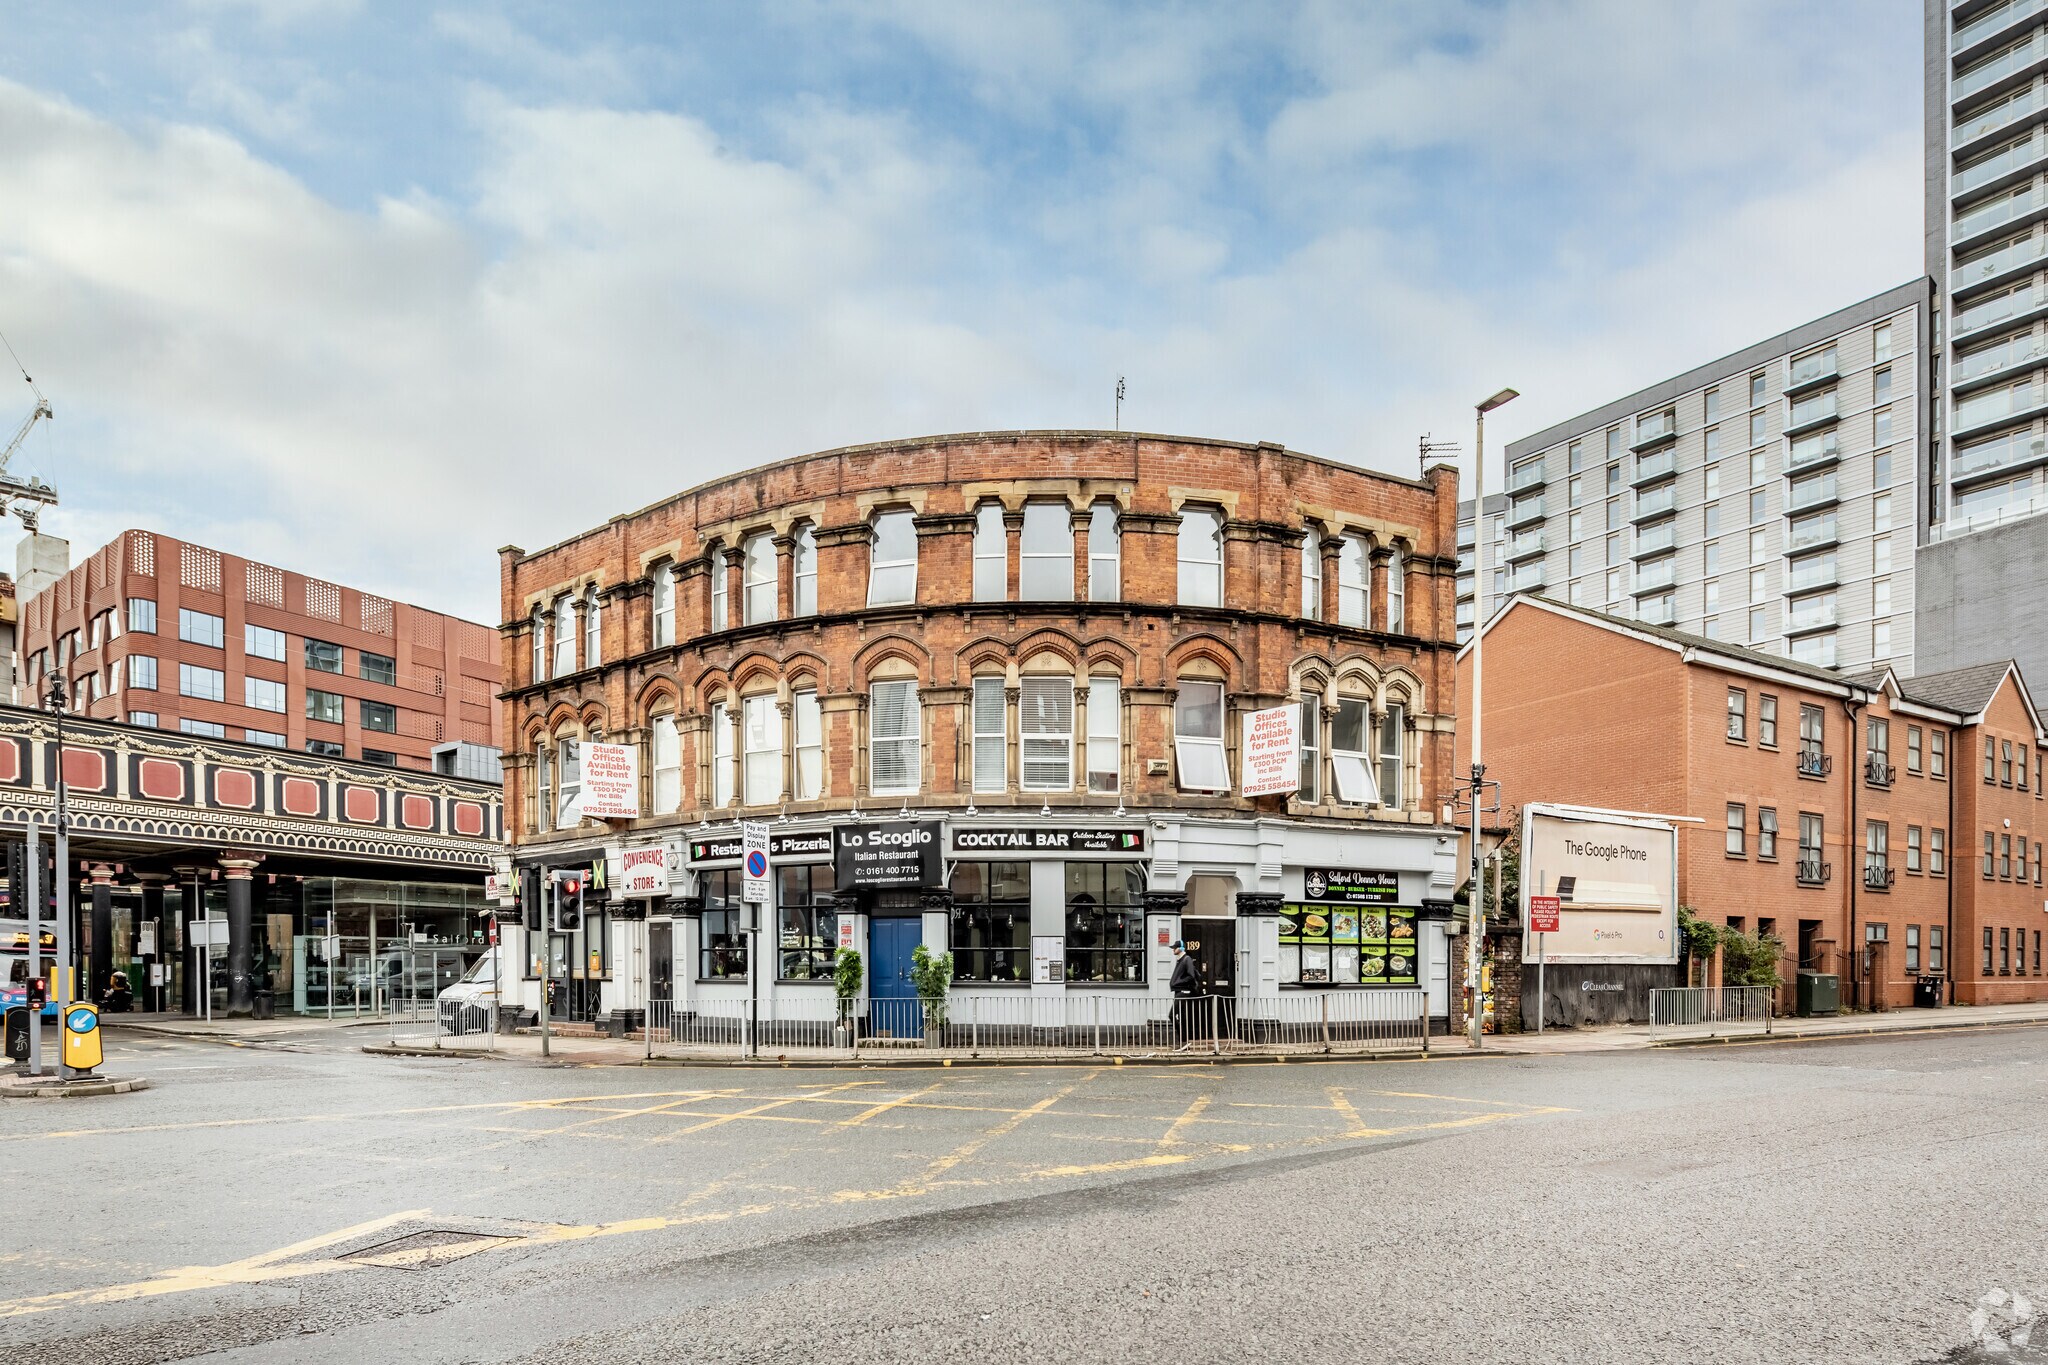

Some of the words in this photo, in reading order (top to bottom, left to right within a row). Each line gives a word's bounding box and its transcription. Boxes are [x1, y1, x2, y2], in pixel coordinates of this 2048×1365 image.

[1256, 710, 1286, 722] Studio
[1255, 720, 1287, 732] Offices
[1250, 727, 1292, 742] Available
[1252, 742, 1265, 750] for
[1268, 737, 1289, 748] Rent
[593, 746, 624, 754] Studio
[592, 754, 626, 762] Offices
[1248, 752, 1274, 762] Starting
[587, 761, 631, 771] Available
[1244, 784, 1266, 793] 07925
[1268, 780, 1296, 790] 558454
[841, 832, 863, 846] Lo
[868, 829, 932, 847] Scoglio
[958, 834, 1031, 846] COCKTAIL
[1036, 834, 1069, 846] BAR
[747, 841, 765, 849] ZONE
[770, 842, 779, 852] &
[782, 838, 830, 852] Pizzeria
[1565, 840, 1582, 855] The
[1585, 842, 1618, 861] Google
[1620, 845, 1647, 861] Phone
[623, 849, 663, 872] CONVENIENCE
[855, 852, 877, 861] Italian
[879, 850, 918, 860] Restaurant
[866, 867, 883, 875] 0161
[634, 876, 654, 890] STORE
[1328, 871, 1351, 885] Salford
[1377, 873, 1397, 885] House
[433, 934, 485, 944] Salford
[1186, 941, 1200, 950] 189
